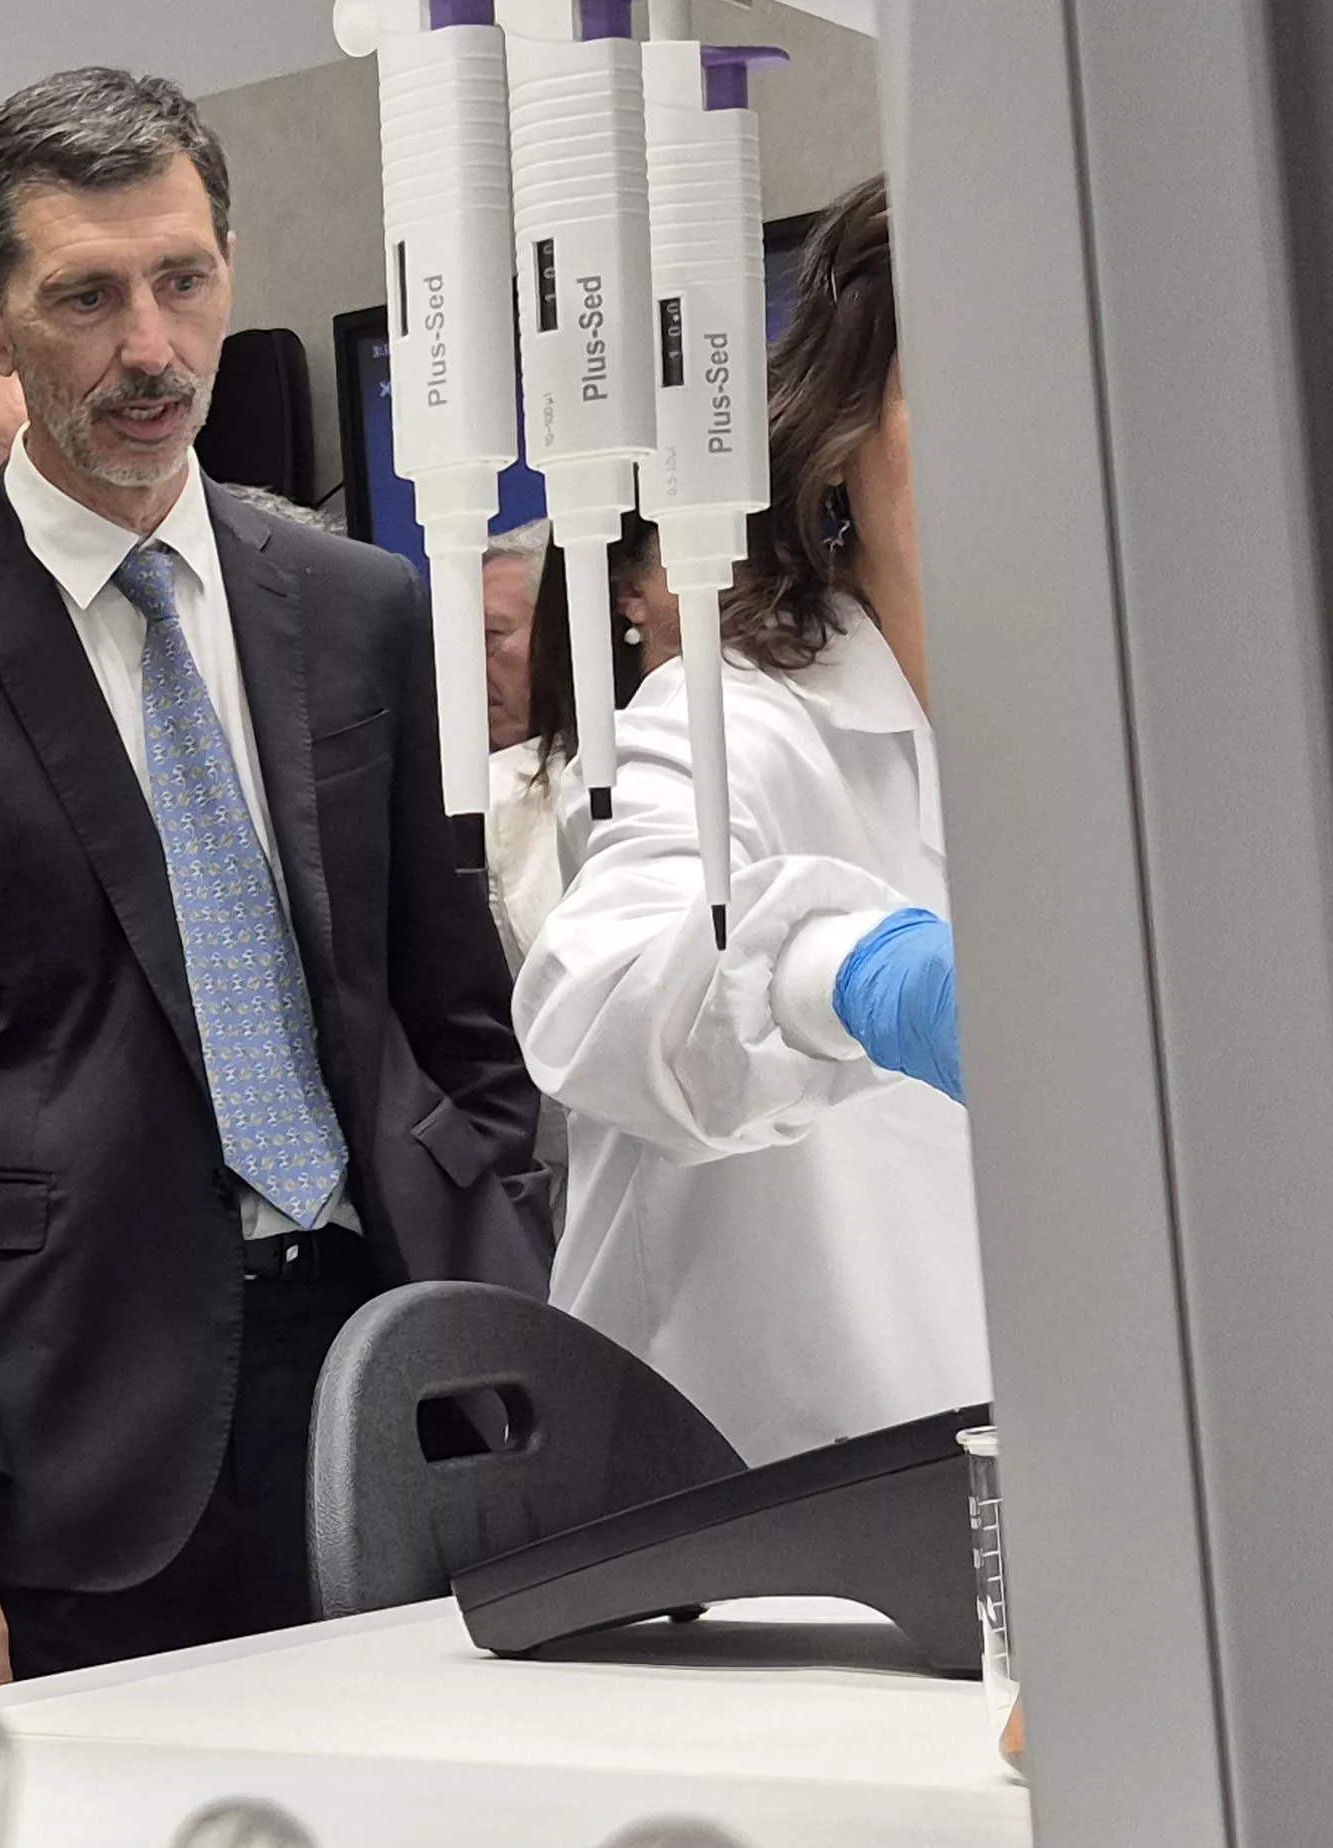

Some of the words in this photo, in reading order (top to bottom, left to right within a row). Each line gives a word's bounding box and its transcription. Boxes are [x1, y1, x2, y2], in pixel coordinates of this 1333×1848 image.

[424, 274, 449, 407] Plus-Sed
[576, 275, 609, 403] Plus-Sed
[704, 332, 734, 455] Plus-Sed
